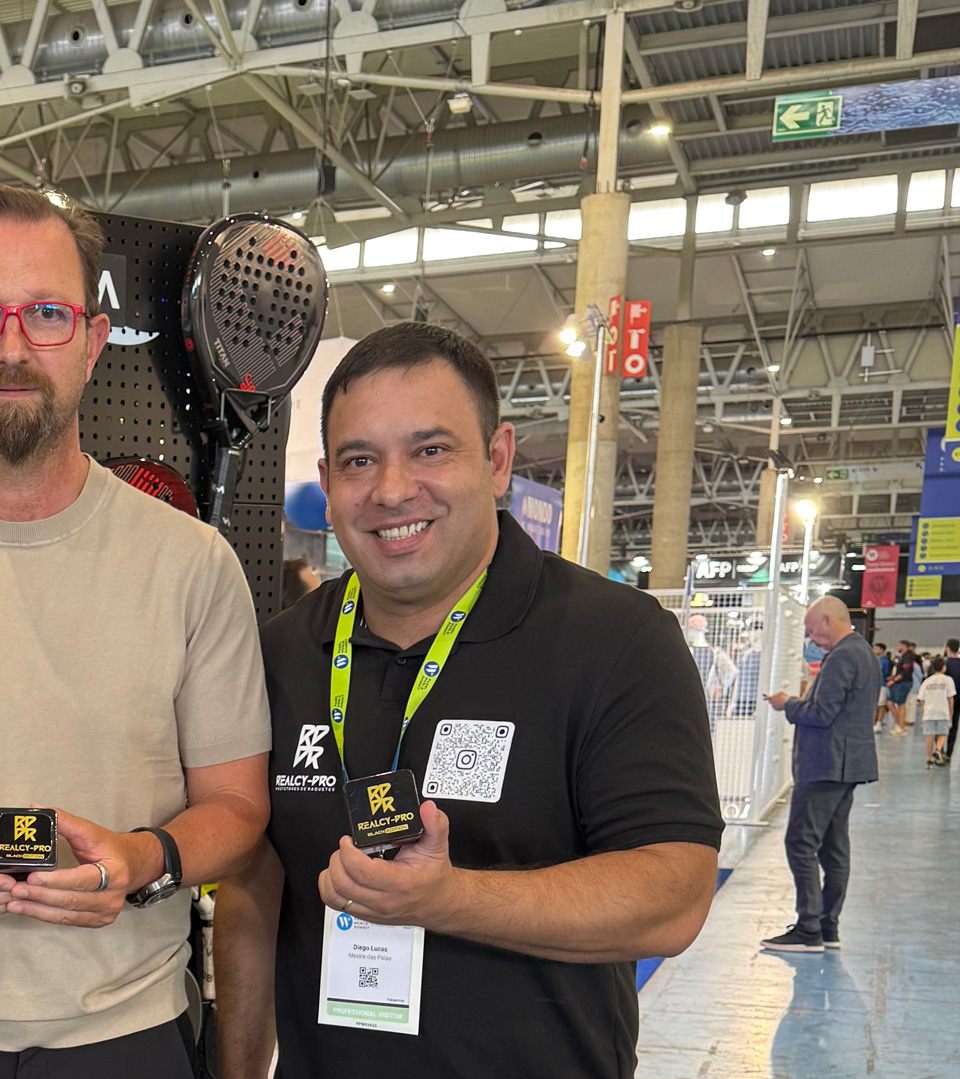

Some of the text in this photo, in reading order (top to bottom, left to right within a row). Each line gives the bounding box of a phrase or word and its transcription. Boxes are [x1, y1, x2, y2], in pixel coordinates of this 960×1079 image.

[213, 336, 231, 369] TITAN
[696, 561, 732, 579] AFP
[275, 774, 337, 788] REALCY-PRO
[357, 812, 415, 831] REALCY-PRO
[0, 844, 52, 853] REALCY-PRO
[353, 944, 388, 953] Diego Lucas
[348, 952, 366, 960] Mestre
[332, 1007, 403, 1020] PROFESSIONAL VISITOR
